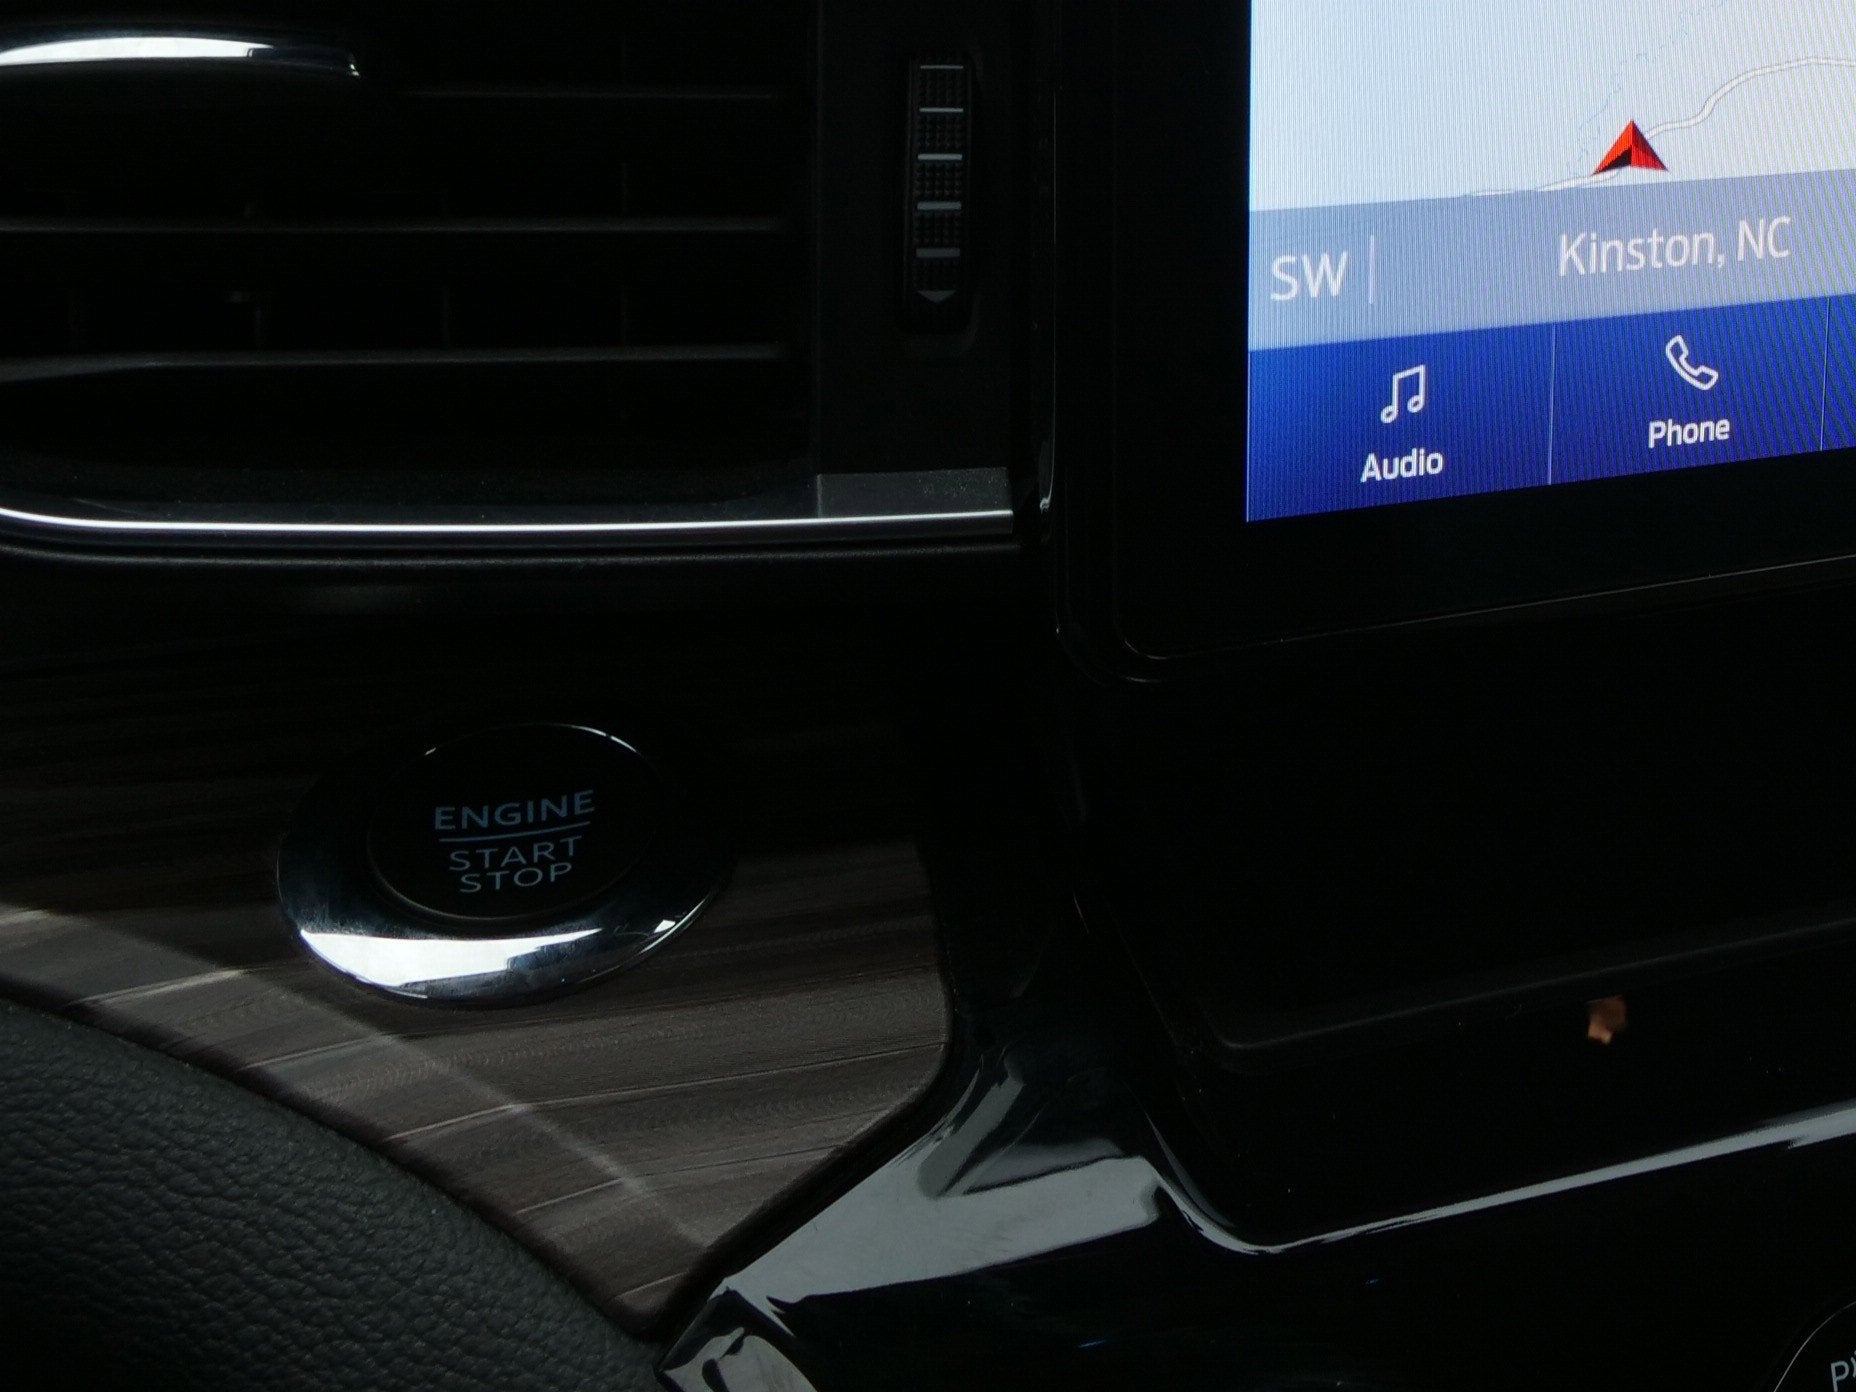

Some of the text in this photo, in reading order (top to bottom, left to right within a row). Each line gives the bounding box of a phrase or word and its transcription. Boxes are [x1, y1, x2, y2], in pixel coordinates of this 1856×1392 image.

[1558, 216, 1791, 277] Kinston, NC
[1271, 250, 1348, 301] SW
[1648, 416, 1730, 449] Phone
[1360, 448, 1443, 483] Audio
[434, 789, 595, 830] ENGINE
[449, 835, 582, 872] START
[459, 862, 572, 893] STOP
